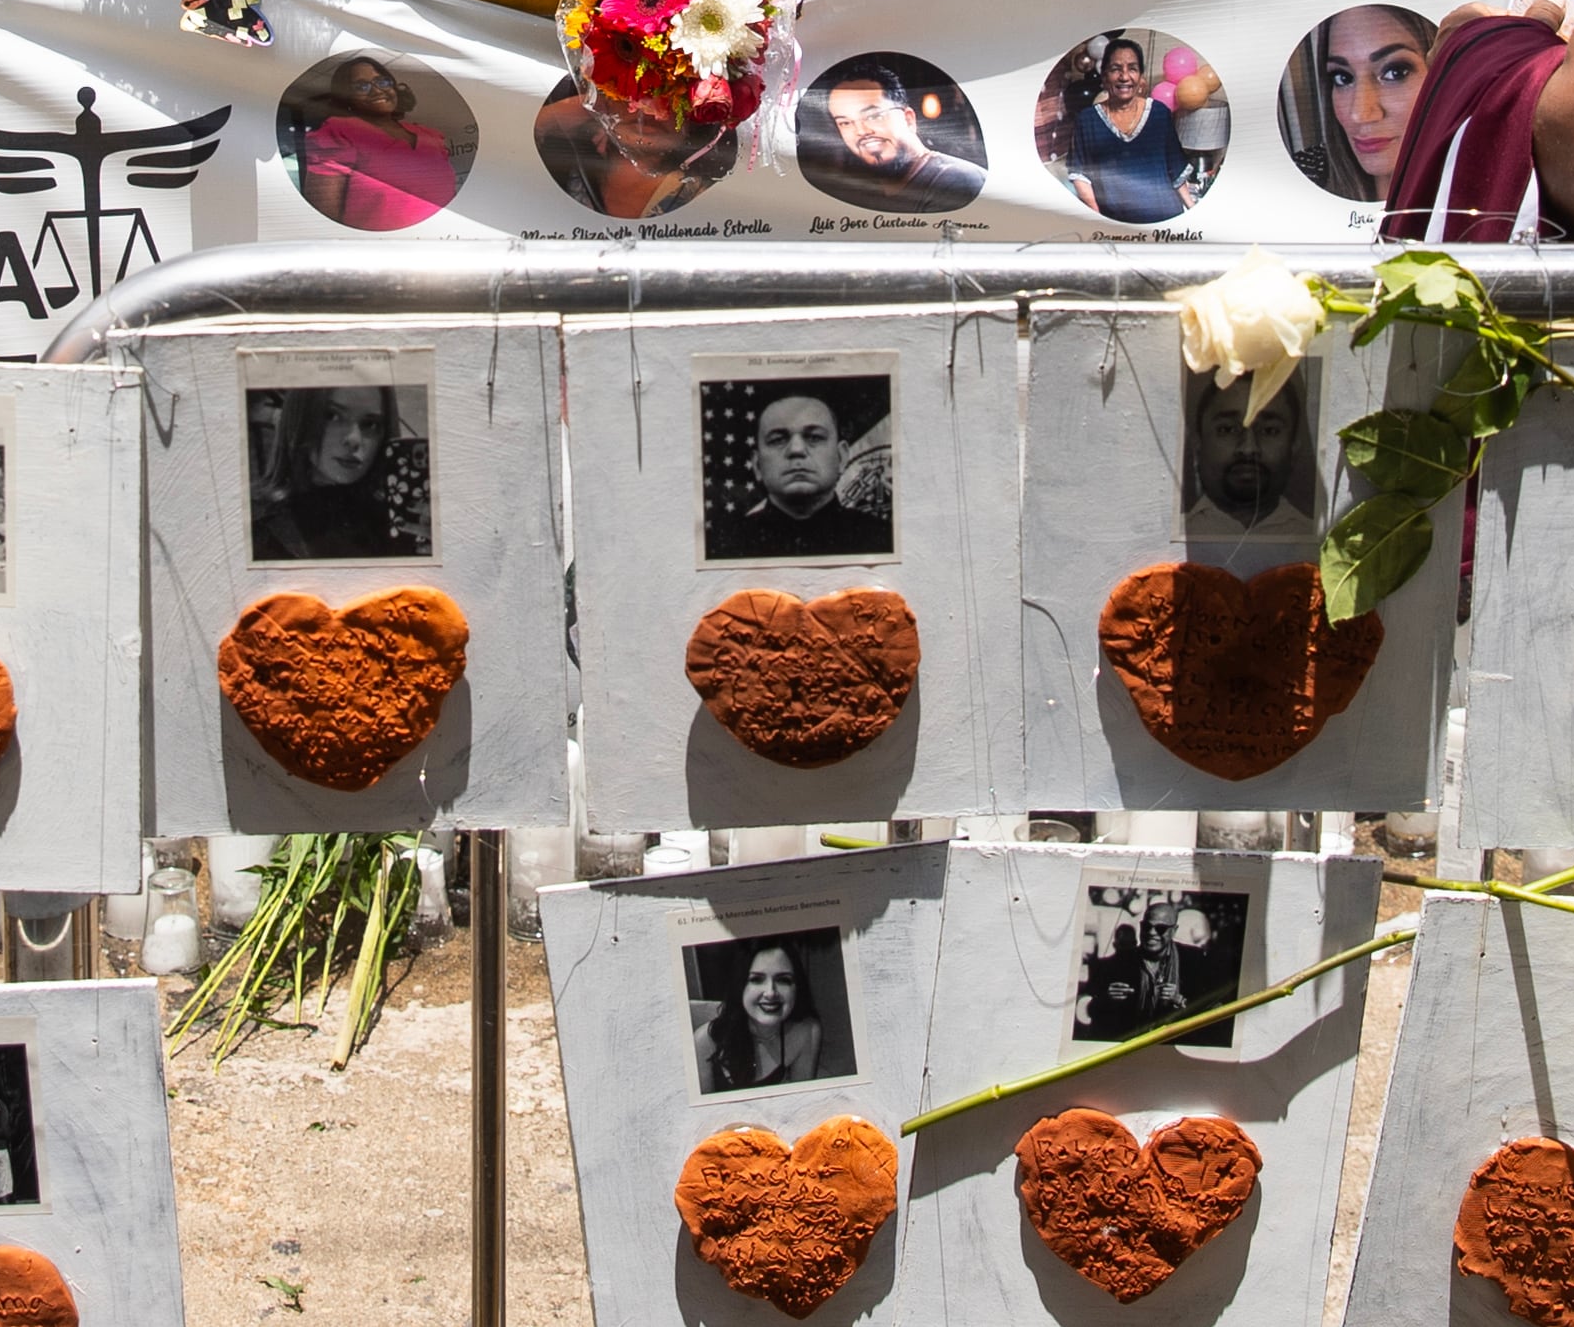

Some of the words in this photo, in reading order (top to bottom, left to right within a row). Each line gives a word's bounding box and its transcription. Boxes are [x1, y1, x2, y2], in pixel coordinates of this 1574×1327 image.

[638, 225, 720, 241] Maldonado
[723, 219, 773, 237] Estrella
[809, 216, 835, 234] Luis
[873, 215, 928, 231] Custodio
